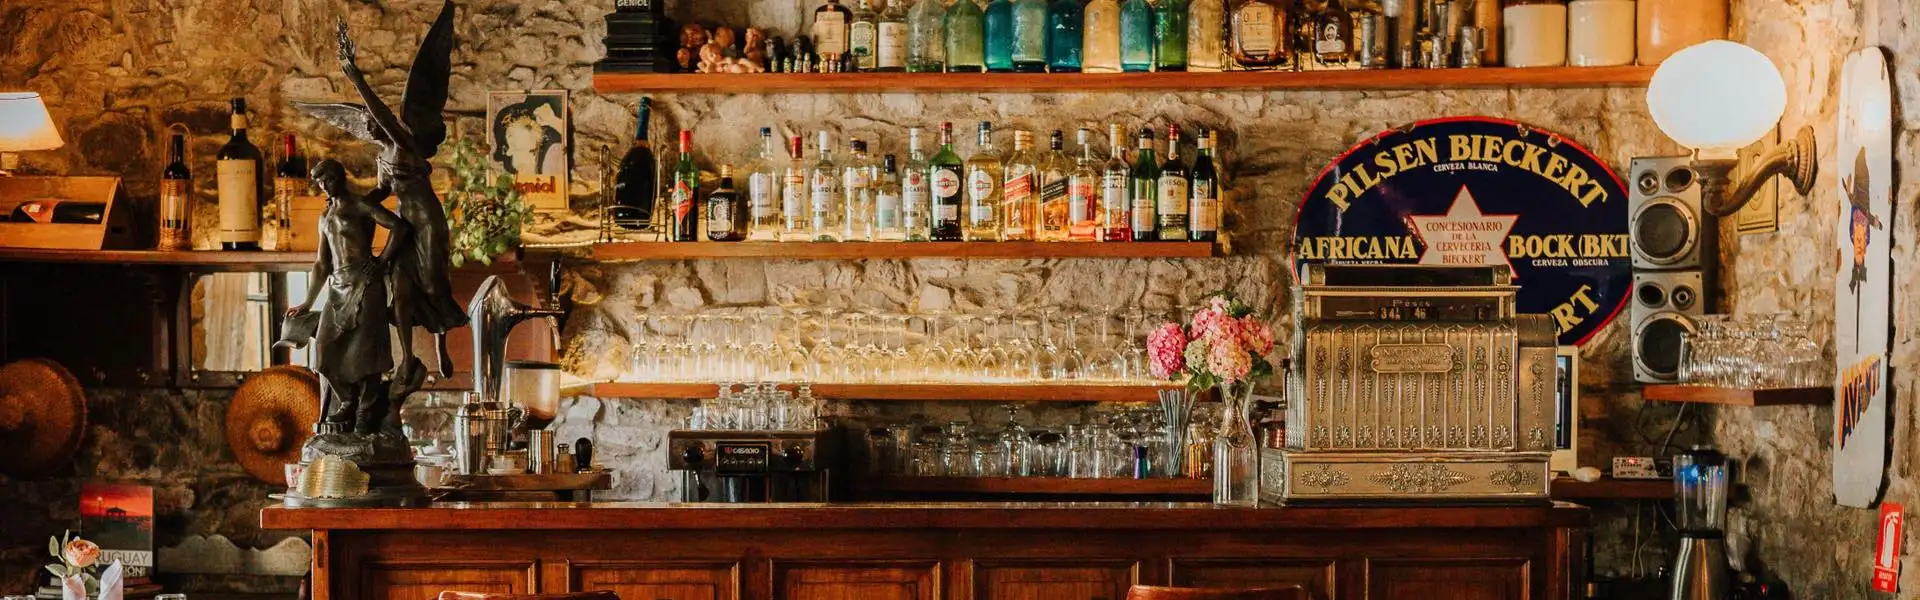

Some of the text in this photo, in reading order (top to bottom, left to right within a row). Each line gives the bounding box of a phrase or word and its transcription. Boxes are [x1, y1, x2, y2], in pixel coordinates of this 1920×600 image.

[1433, 161, 1499, 173] CERVEZA BLANCA
[1325, 135, 1608, 213] PILSEN BIECKERT
[1425, 221, 1503, 232] CONCESIONARIO
[1452, 232, 1477, 241] DE LA
[1299, 235, 1418, 259] AFRICANA
[1436, 241, 1492, 252] CERVECERIA
[1508, 235, 1574, 258] BOCK
[1442, 253, 1486, 265] BIECKERT
[1531, 258, 1609, 267] CERVEZA OBSCURA
[1551, 284, 1599, 337] RT
